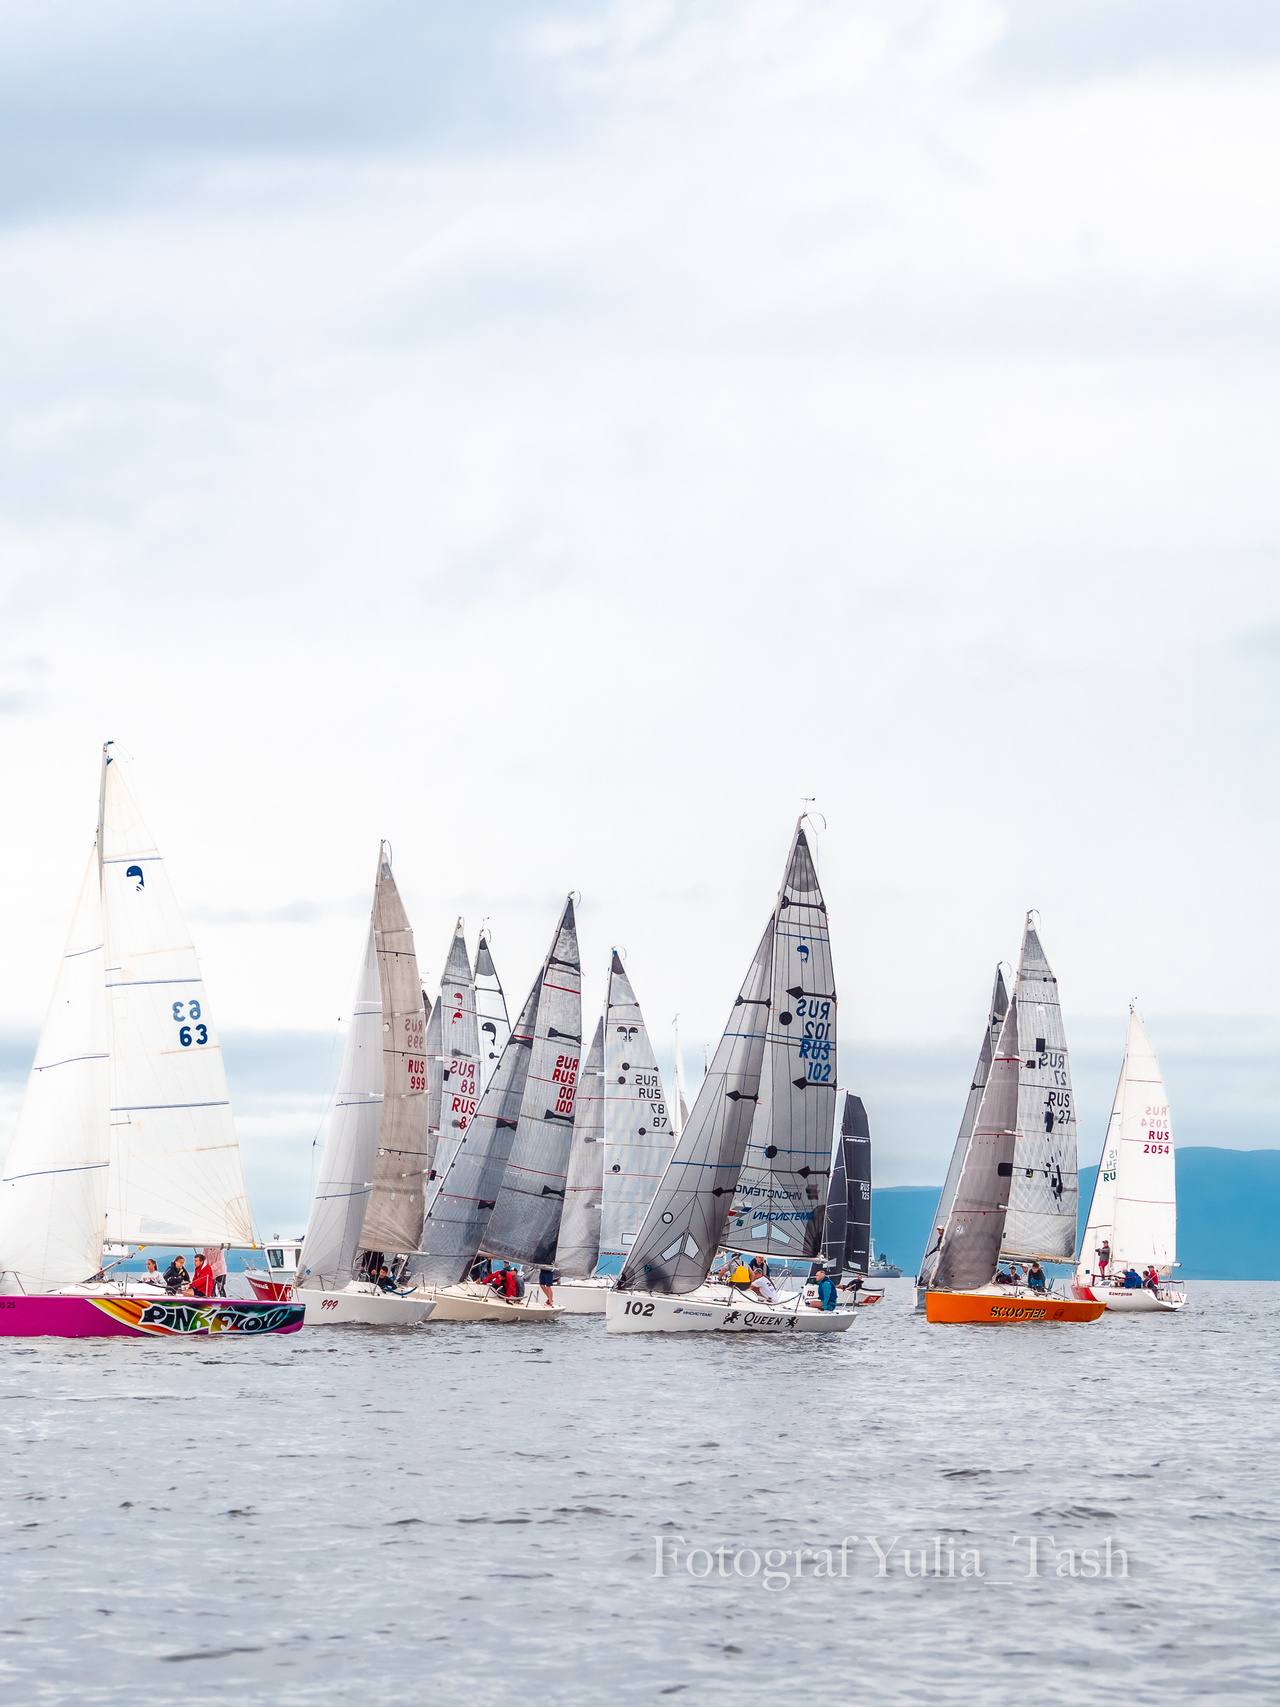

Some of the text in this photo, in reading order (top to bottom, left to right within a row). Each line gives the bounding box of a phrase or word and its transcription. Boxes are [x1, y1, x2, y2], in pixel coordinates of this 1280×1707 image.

[179, 1023, 208, 1047] 63
[798, 1039, 831, 1061] RUS
[408, 1059, 425, 1075] RUS
[807, 1061, 832, 1082] 102
[410, 1076, 426, 1091] 999
[552, 1068, 576, 1085] RUS
[638, 1087, 662, 1099] RUS
[1048, 1091, 1070, 1108] RUS
[451, 1097, 476, 1116] RUS
[555, 1098, 573, 1114] 100
[459, 1115, 472, 1130] 8
[653, 1117, 668, 1128] 87
[1057, 1109, 1071, 1125] 27
[1148, 1130, 1170, 1141] RUS
[1143, 1144, 1170, 1155] 2054
[623, 1300, 656, 1317] 102
[990, 1306, 1046, 1320] SCOOTER
